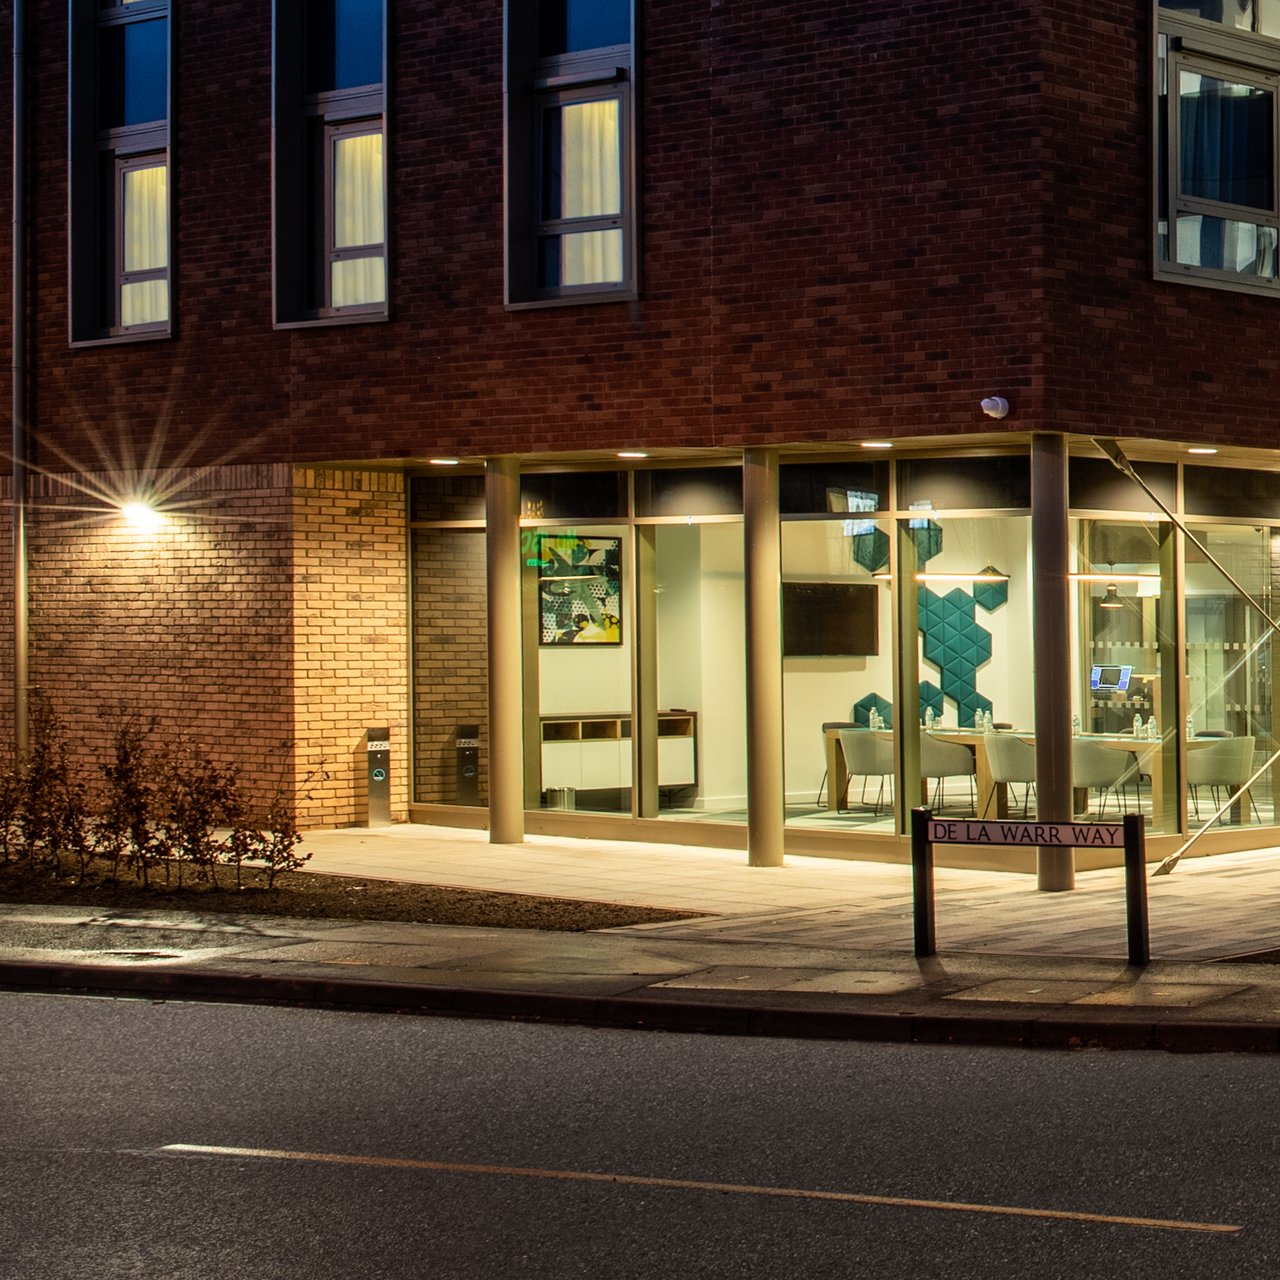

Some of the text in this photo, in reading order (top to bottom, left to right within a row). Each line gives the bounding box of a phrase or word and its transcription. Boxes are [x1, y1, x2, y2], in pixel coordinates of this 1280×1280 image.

[933, 823, 1119, 845] DE LA WARR WAY
